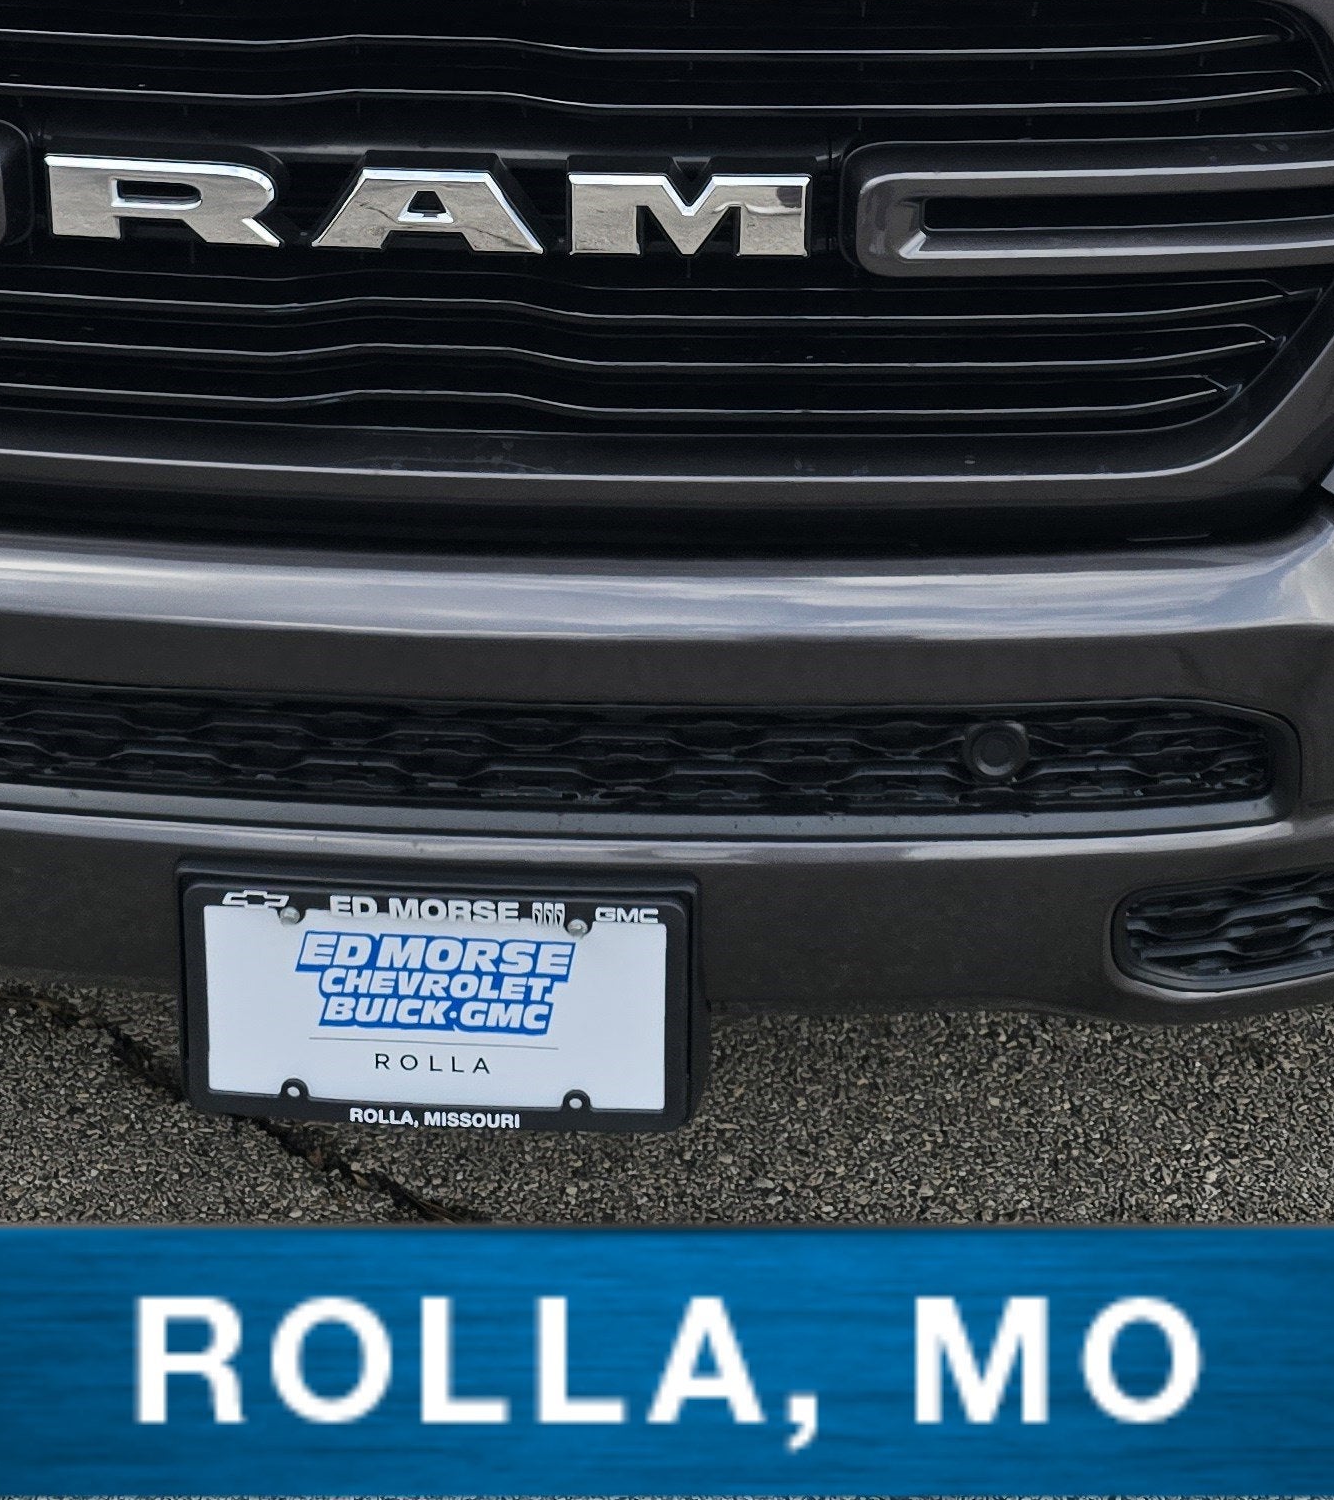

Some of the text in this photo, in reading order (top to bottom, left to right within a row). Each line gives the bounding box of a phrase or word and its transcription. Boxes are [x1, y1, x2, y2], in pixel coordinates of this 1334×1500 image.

[44, 152, 813, 258] RAM
[329, 895, 520, 924] ED MORSE
[594, 906, 659, 924] GMC
[299, 933, 573, 975] ED MORSE
[320, 967, 552, 1002] CHEVROLET
[374, 1053, 491, 1075] ROLLA
[349, 1107, 521, 1129] ROLLA, MISSOURI
